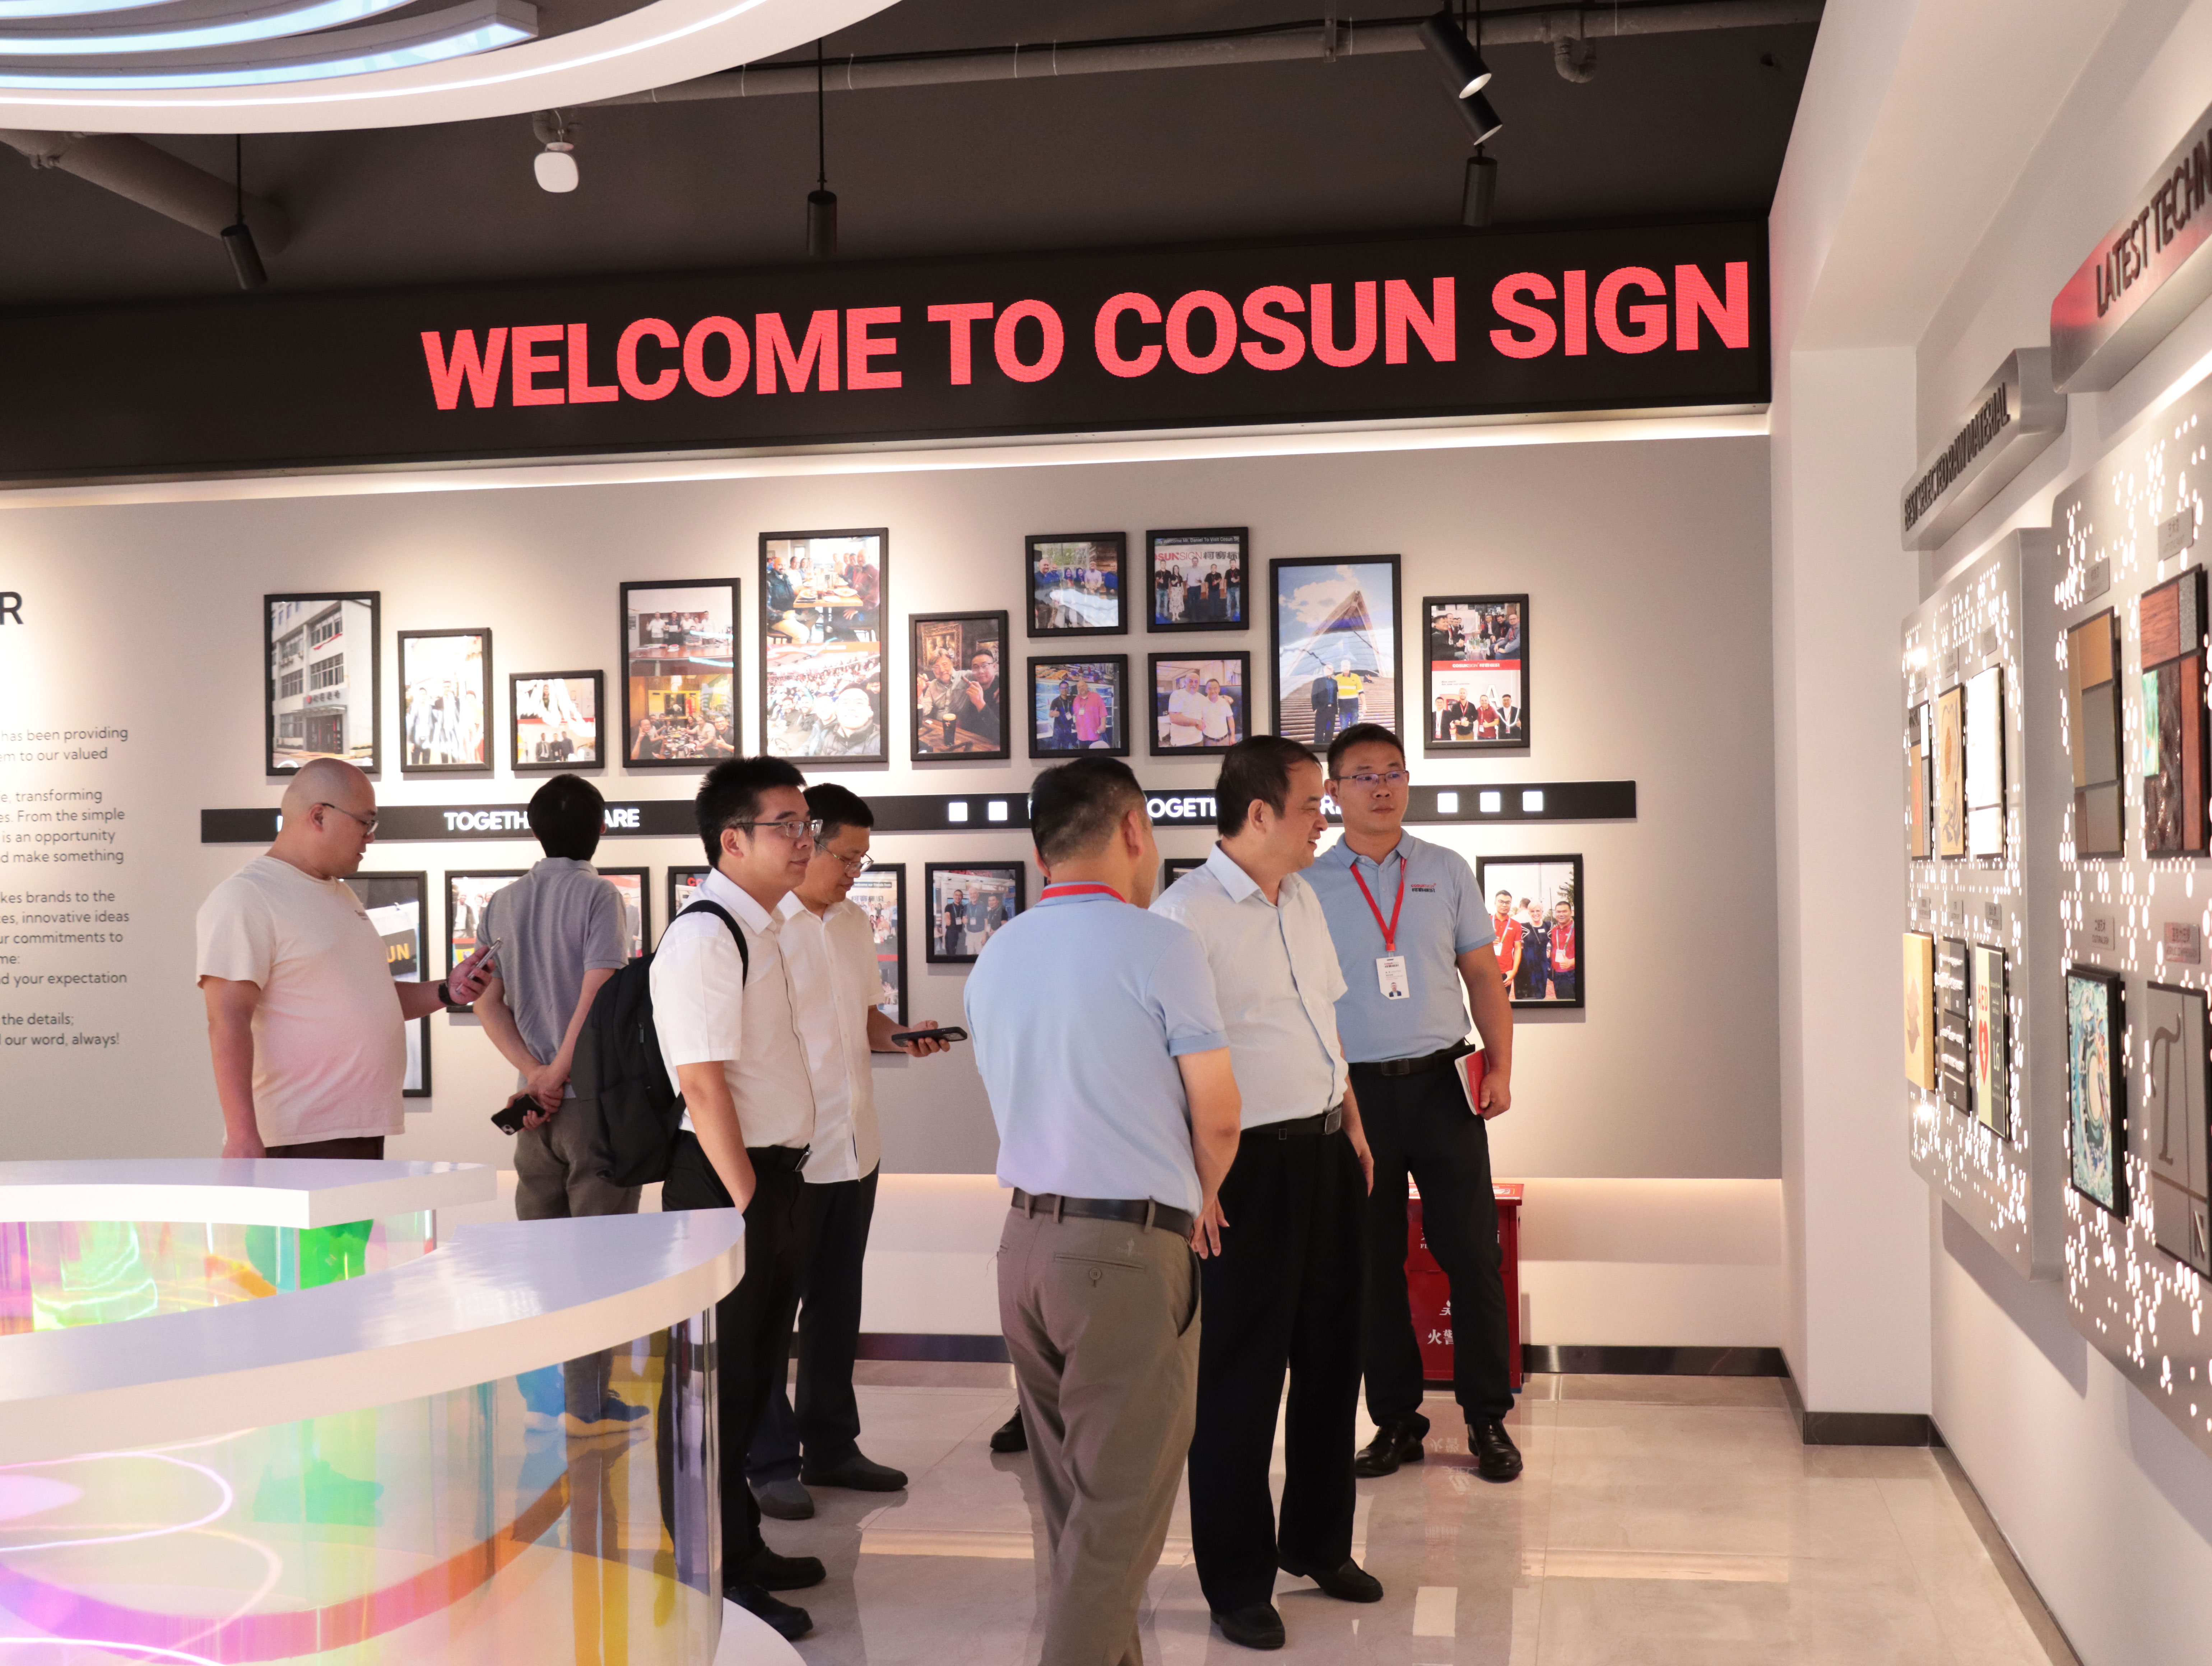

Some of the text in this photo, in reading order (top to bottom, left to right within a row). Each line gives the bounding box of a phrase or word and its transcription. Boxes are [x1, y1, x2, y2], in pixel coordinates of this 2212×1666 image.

[2096, 206, 2149, 318] LATEST
[420, 262, 1748, 409] WELCOME TO COSUN SIGN
[1, 726, 128, 743] has been providing
[20, 751, 33, 761] to
[37, 752, 59, 760] our
[63, 747, 107, 759] valued
[16, 789, 102, 804] transforming
[18, 810, 52, 822] From
[56, 809, 78, 821] the
[82, 808, 125, 823] simple
[1147, 797, 1216, 818] OGET
[444, 809, 640, 830] TOGETH ARE
[2, 828, 115, 845] is an opportunity
[13, 851, 49, 862] make
[54, 849, 124, 864] something
[26, 890, 71, 903] brands
[76, 892, 89, 902] to
[93, 890, 115, 901] the
[0, 910, 129, 925] es, innovative ideas
[14, 931, 105, 944] commitments
[110, 933, 123, 942] to
[14, 975, 44, 987] your
[48, 971, 127, 987] expectation
[1978, 984, 1988, 1011] AED
[2, 1012, 74, 1026] the details;
[5, 1032, 119, 1048] our word, always!
